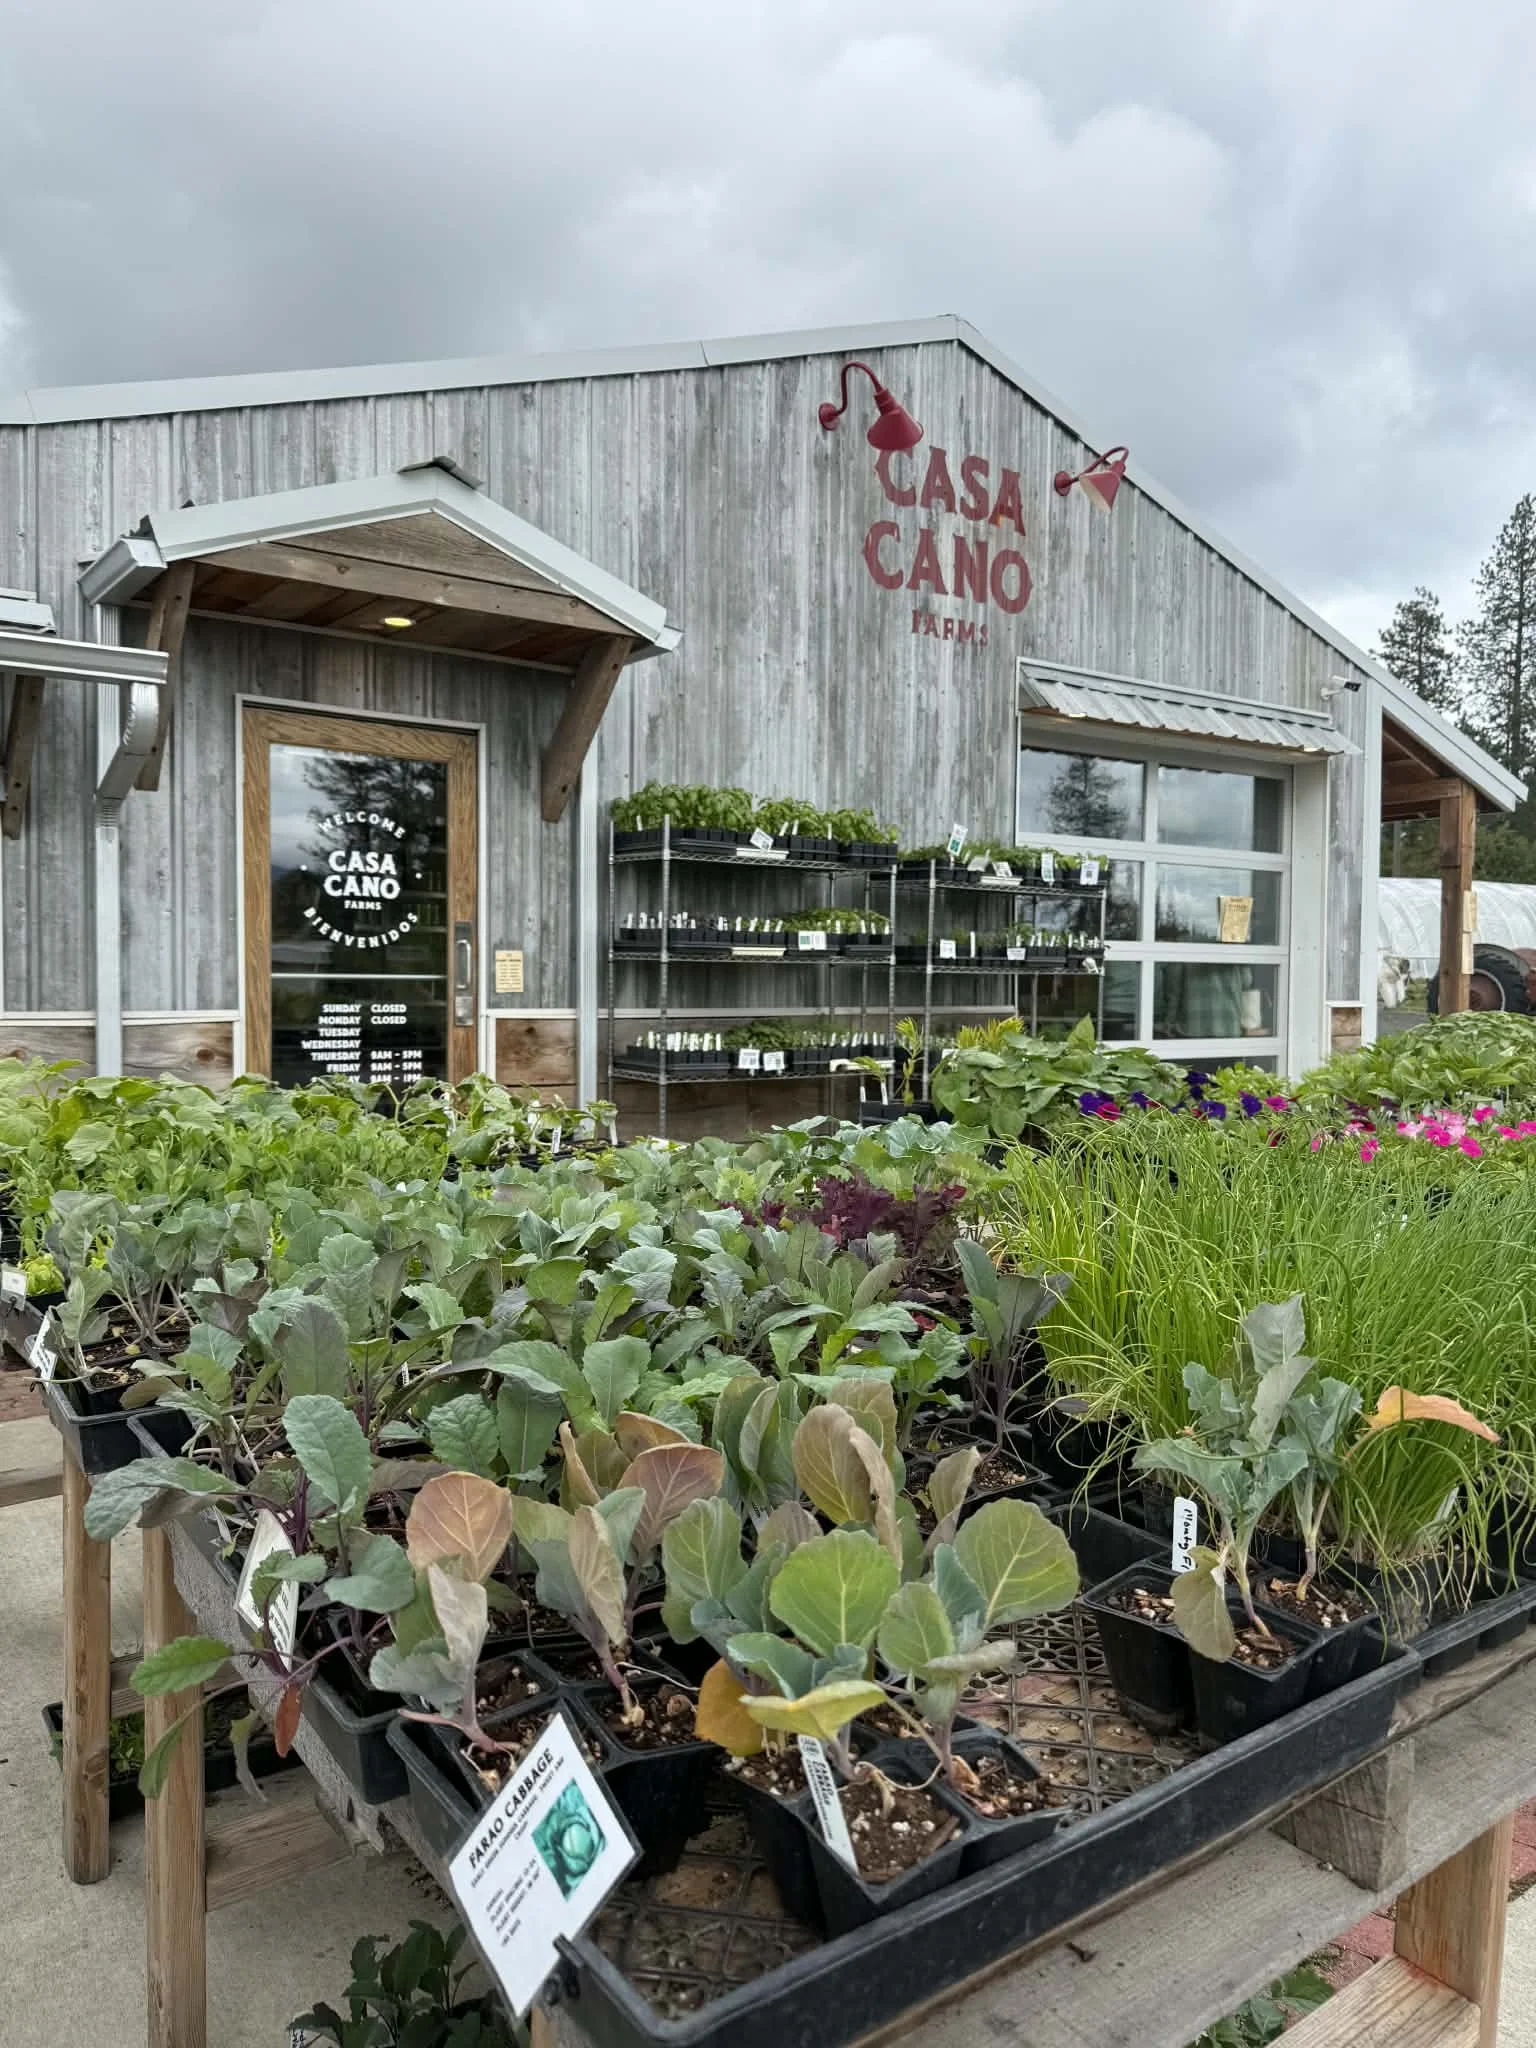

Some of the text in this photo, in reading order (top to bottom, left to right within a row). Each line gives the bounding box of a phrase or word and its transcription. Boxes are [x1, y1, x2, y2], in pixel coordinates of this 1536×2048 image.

[875, 446, 1026, 536] CASA
[863, 520, 1033, 615] CANO
[911, 610, 988, 648] FARMS
[319, 811, 405, 838] WELCOME
[328, 850, 397, 875] CASA
[323, 874, 400, 899] CANO
[344, 900, 382, 910] FARMS
[303, 907, 418, 948] BIENVENIDOS
[318, 1016, 407, 1025] MONDAY CLOSED
[322, 1004, 407, 1013] SUNDAY CLOSED
[301, 1040, 361, 1049] WEDNESDAY
[318, 1028, 361, 1037] TUESDAY
[311, 1052, 361, 1061] THURSDAY
[402, 1050, 422, 1059] 5PM
[326, 1064, 360, 1073] FRIDAY
[402, 1062, 422, 1070] 5PM
[469, 1817, 505, 1869] FARAO
[504, 1748, 553, 1819] CABBAGE
